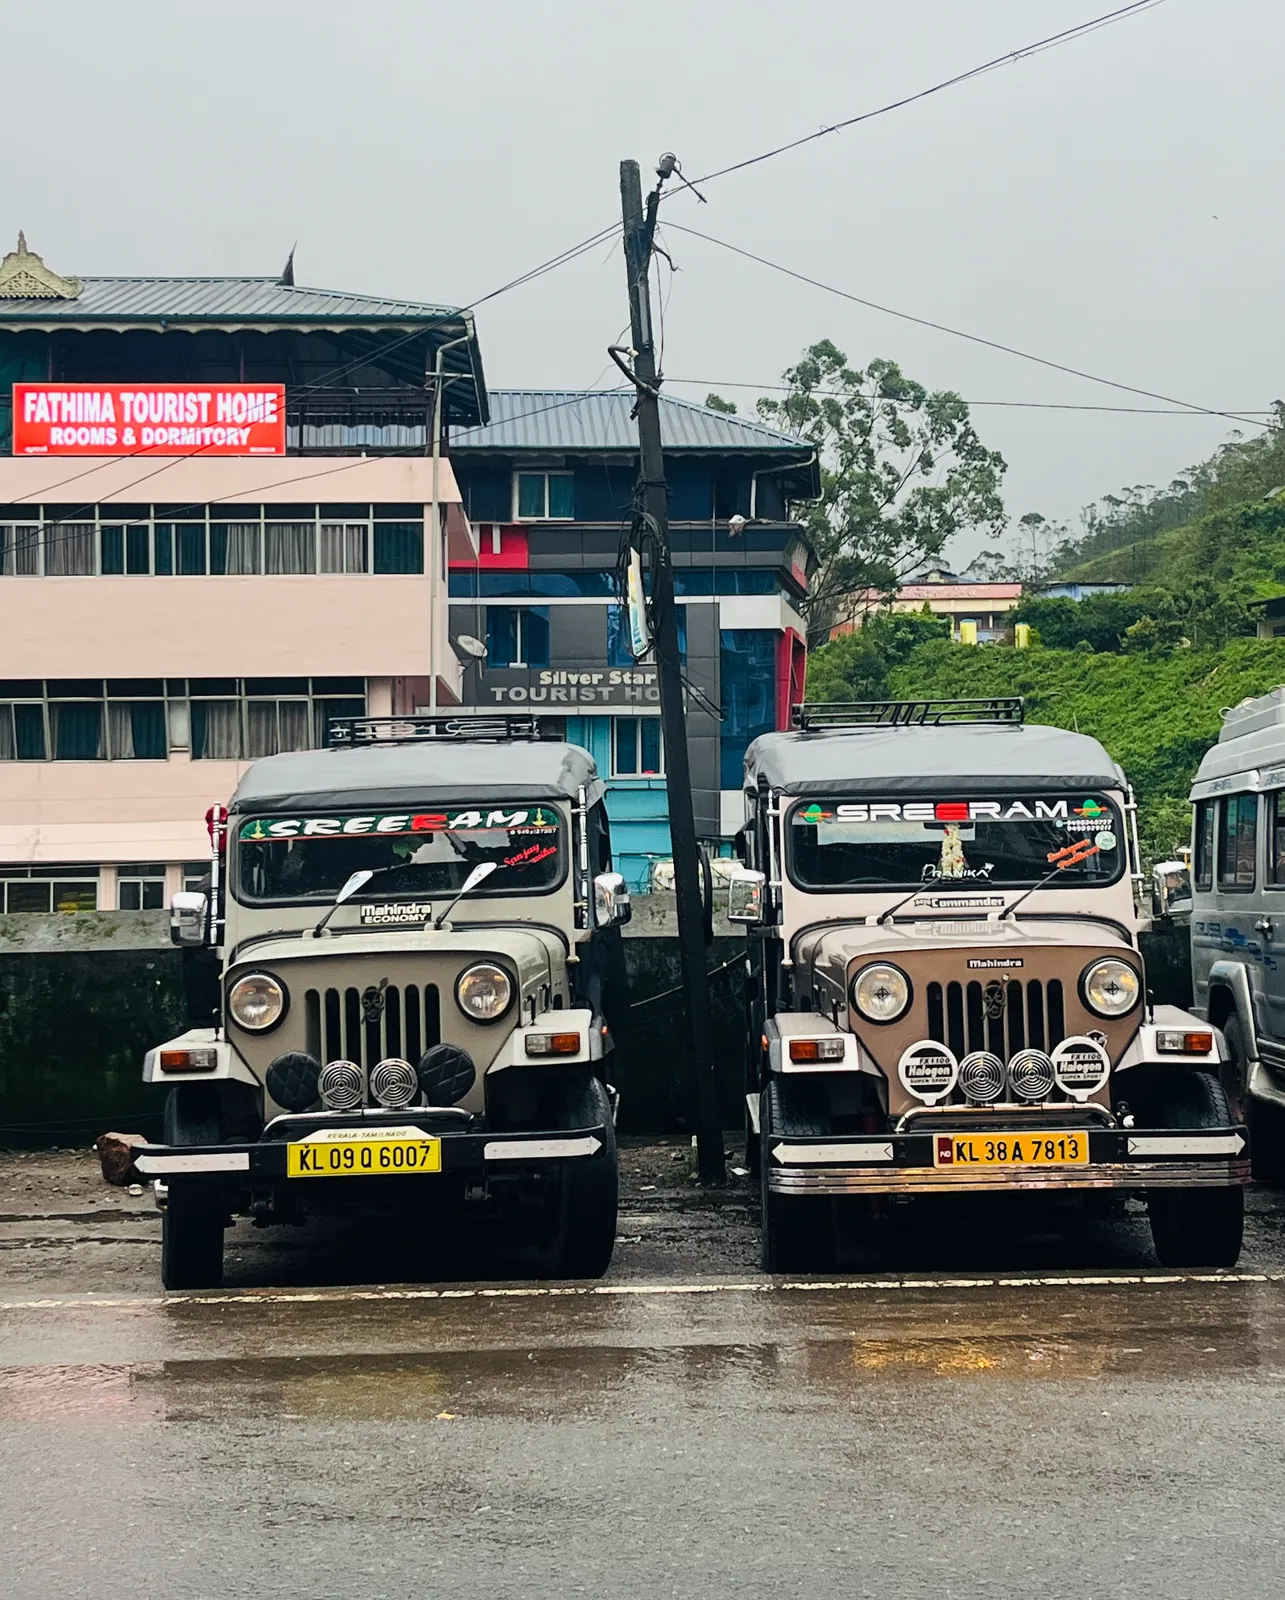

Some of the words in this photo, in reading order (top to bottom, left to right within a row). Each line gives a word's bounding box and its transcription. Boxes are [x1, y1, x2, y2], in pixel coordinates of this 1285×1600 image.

[24, 392, 116, 423] FATHIMA
[120, 392, 212, 423] TOURIST
[217, 392, 278, 423] HOME
[51, 426, 118, 446] ROOMS
[122, 427, 136, 445] &
[539, 670, 603, 685] Silver
[609, 670, 656, 685] Star
[490, 686, 615, 702] TOURIST
[624, 686, 706, 701] HOE
[836, 800, 1069, 822] SREERAM
[269, 811, 529, 838] SREERAM
[361, 902, 431, 917] Mahindra
[931, 897, 1004, 908] Commander
[364, 913, 427, 924] ECONOMY
[969, 959, 1022, 968] Mahindra
[908, 1064, 951, 1079] Halogen
[1059, 1060, 1102, 1075] Halogen
[955, 1141, 980, 1162] KL
[985, 1140, 1008, 1162] 38
[1011, 1140, 1024, 1162] A
[1031, 1138, 1080, 1161] 7813
[300, 1148, 324, 1171] KL
[329, 1147, 355, 1170] 09
[360, 1147, 372, 1168] Q
[379, 1145, 431, 1168] 6007
